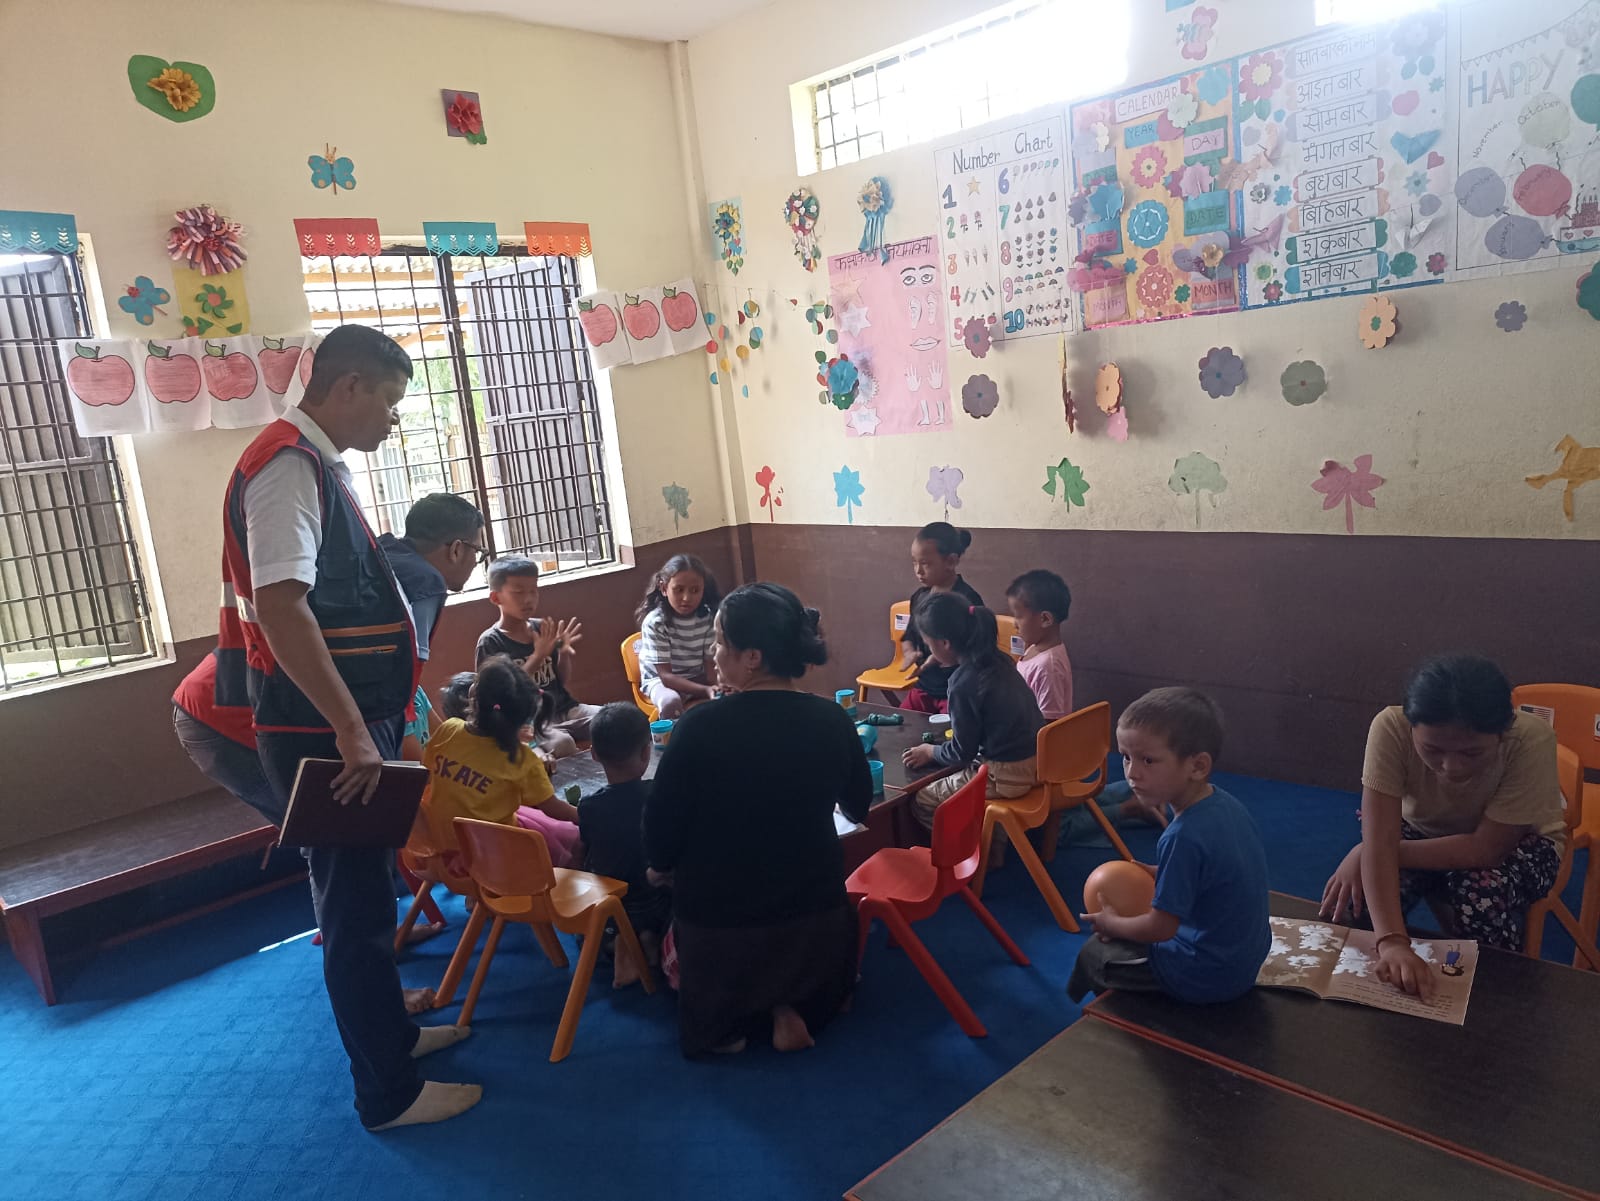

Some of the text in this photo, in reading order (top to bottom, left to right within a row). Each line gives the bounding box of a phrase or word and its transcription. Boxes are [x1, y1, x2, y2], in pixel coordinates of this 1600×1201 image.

[1467, 48, 1565, 108] HAPPY
[1118, 85, 1178, 117] CALENDAR
[1126, 123, 1155, 139] YEAR
[1191, 134, 1219, 152] DAY
[951, 127, 1053, 175] Number Chart
[998, 167, 1010, 195] 6
[942, 184, 957, 209] 1
[946, 216, 957, 239] 2
[998, 204, 1011, 230] 7
[948, 253, 958, 275] 3
[1000, 240, 1013, 266] 8
[950, 285, 961, 307] 4
[1002, 276, 1014, 303] 9
[1194, 280, 1232, 298] MONTH
[953, 316, 965, 341] 5
[1003, 308, 1025, 334] 10
[433, 754, 494, 795] SKATE
